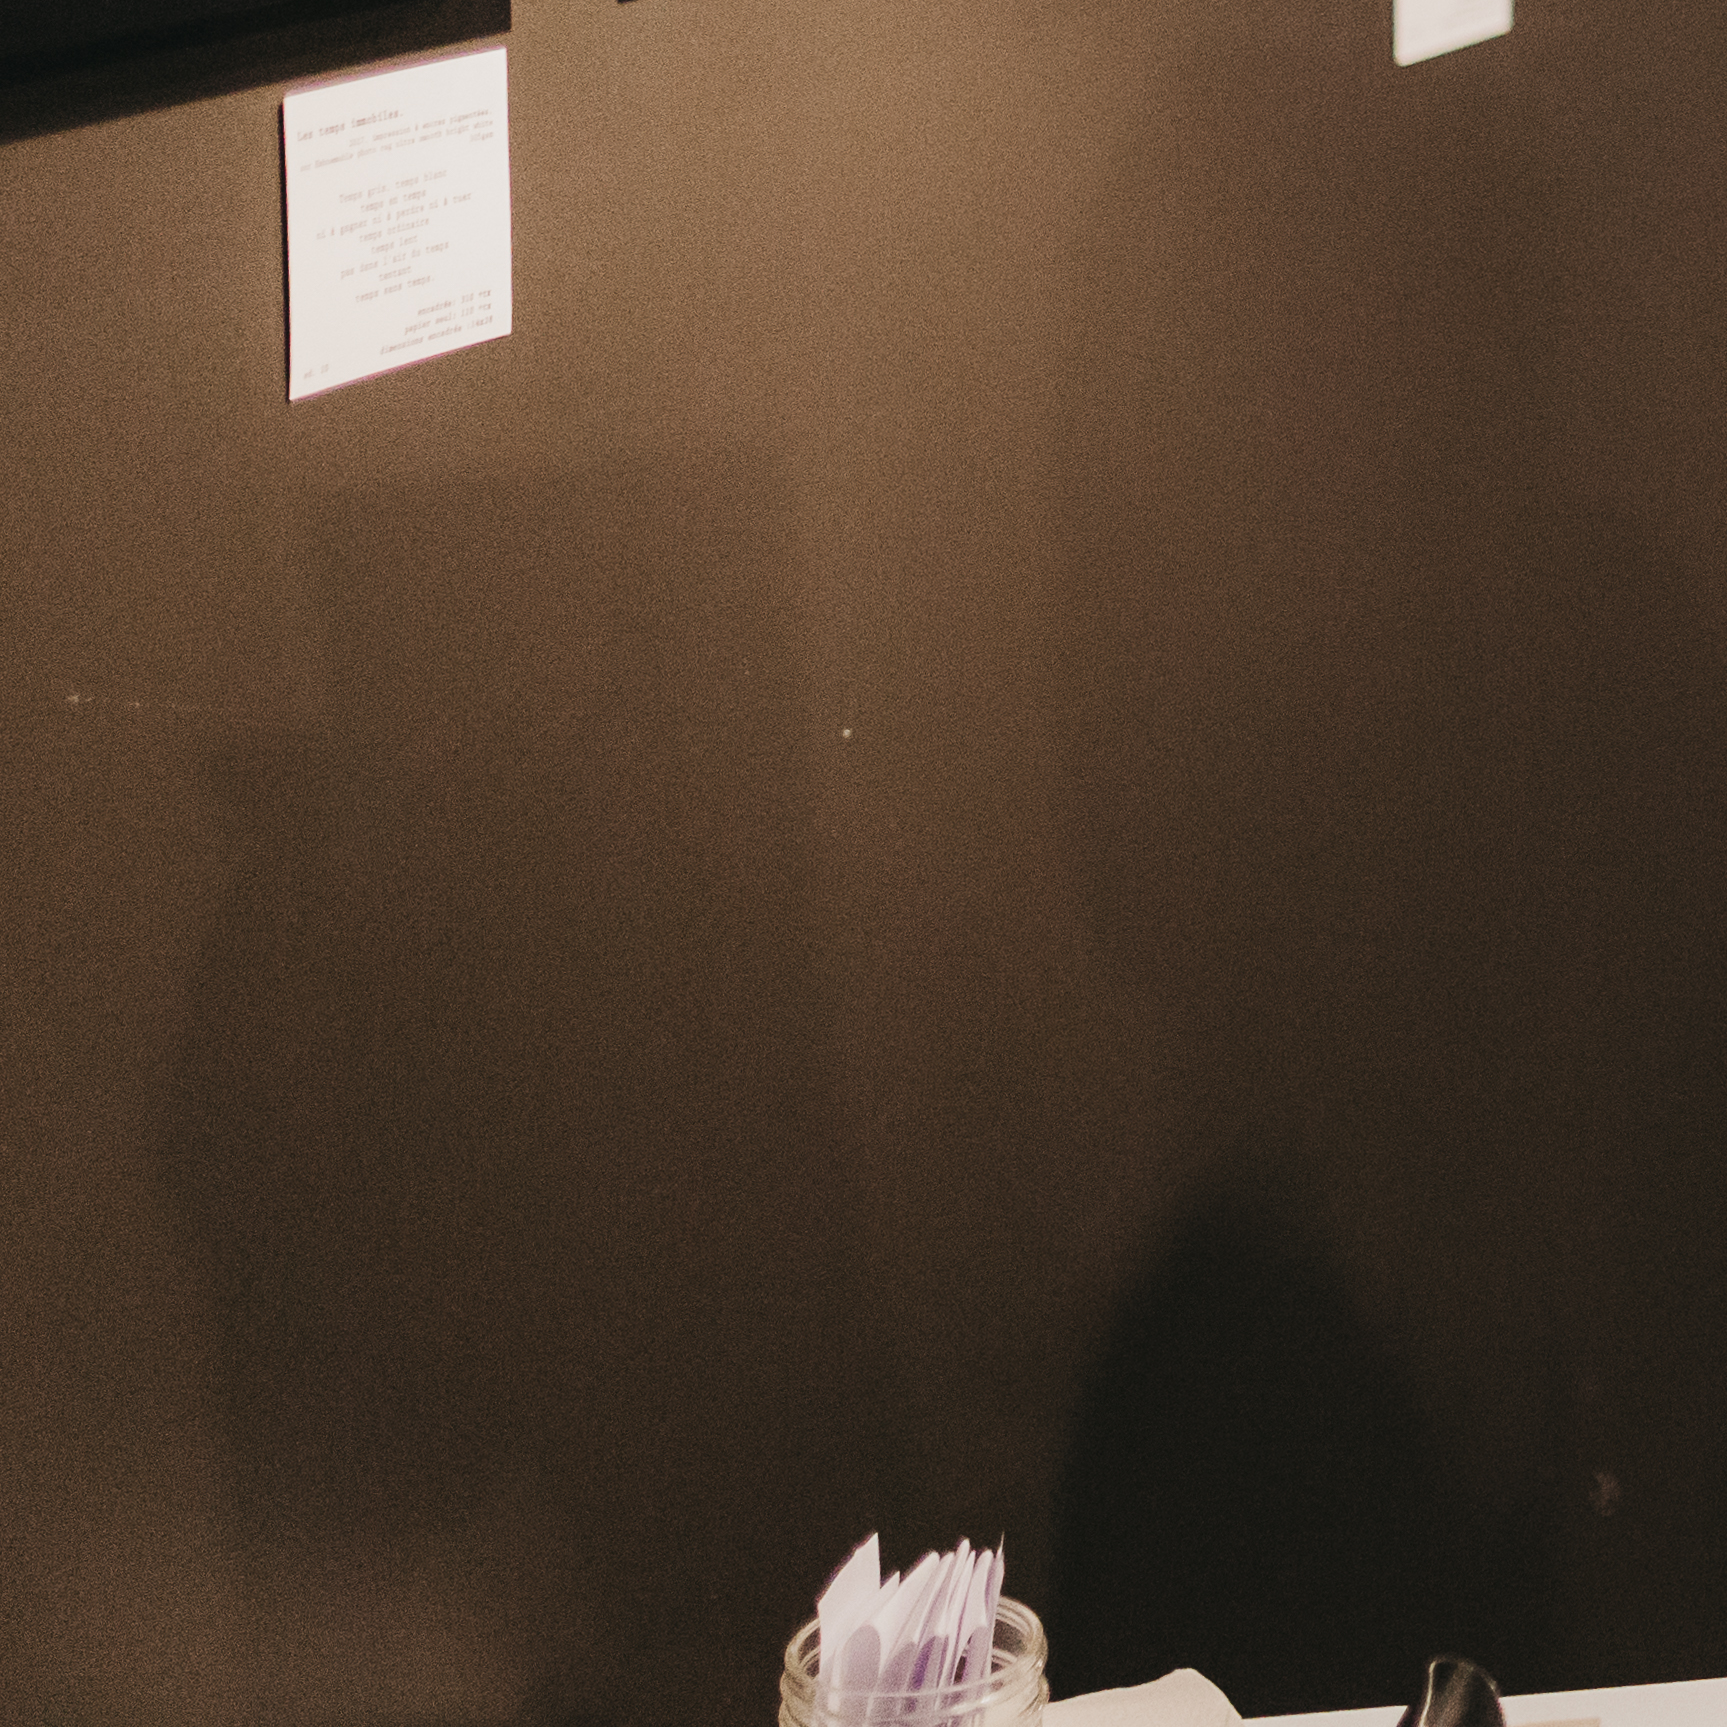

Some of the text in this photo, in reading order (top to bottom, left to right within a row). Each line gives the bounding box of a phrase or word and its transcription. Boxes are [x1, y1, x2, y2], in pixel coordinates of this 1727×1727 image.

[297, 109, 404, 142] Les temps immobiles.
[339, 191, 363, 204] Temps
[395, 176, 419, 189] temps
[423, 169, 447, 182] blanc
[360, 200, 384, 213] temps
[403, 189, 427, 202] temps
[359, 230, 382, 243] temps
[371, 235, 418, 254] temps lent
[425, 241, 449, 254] temps
[355, 290, 379, 303] temps
